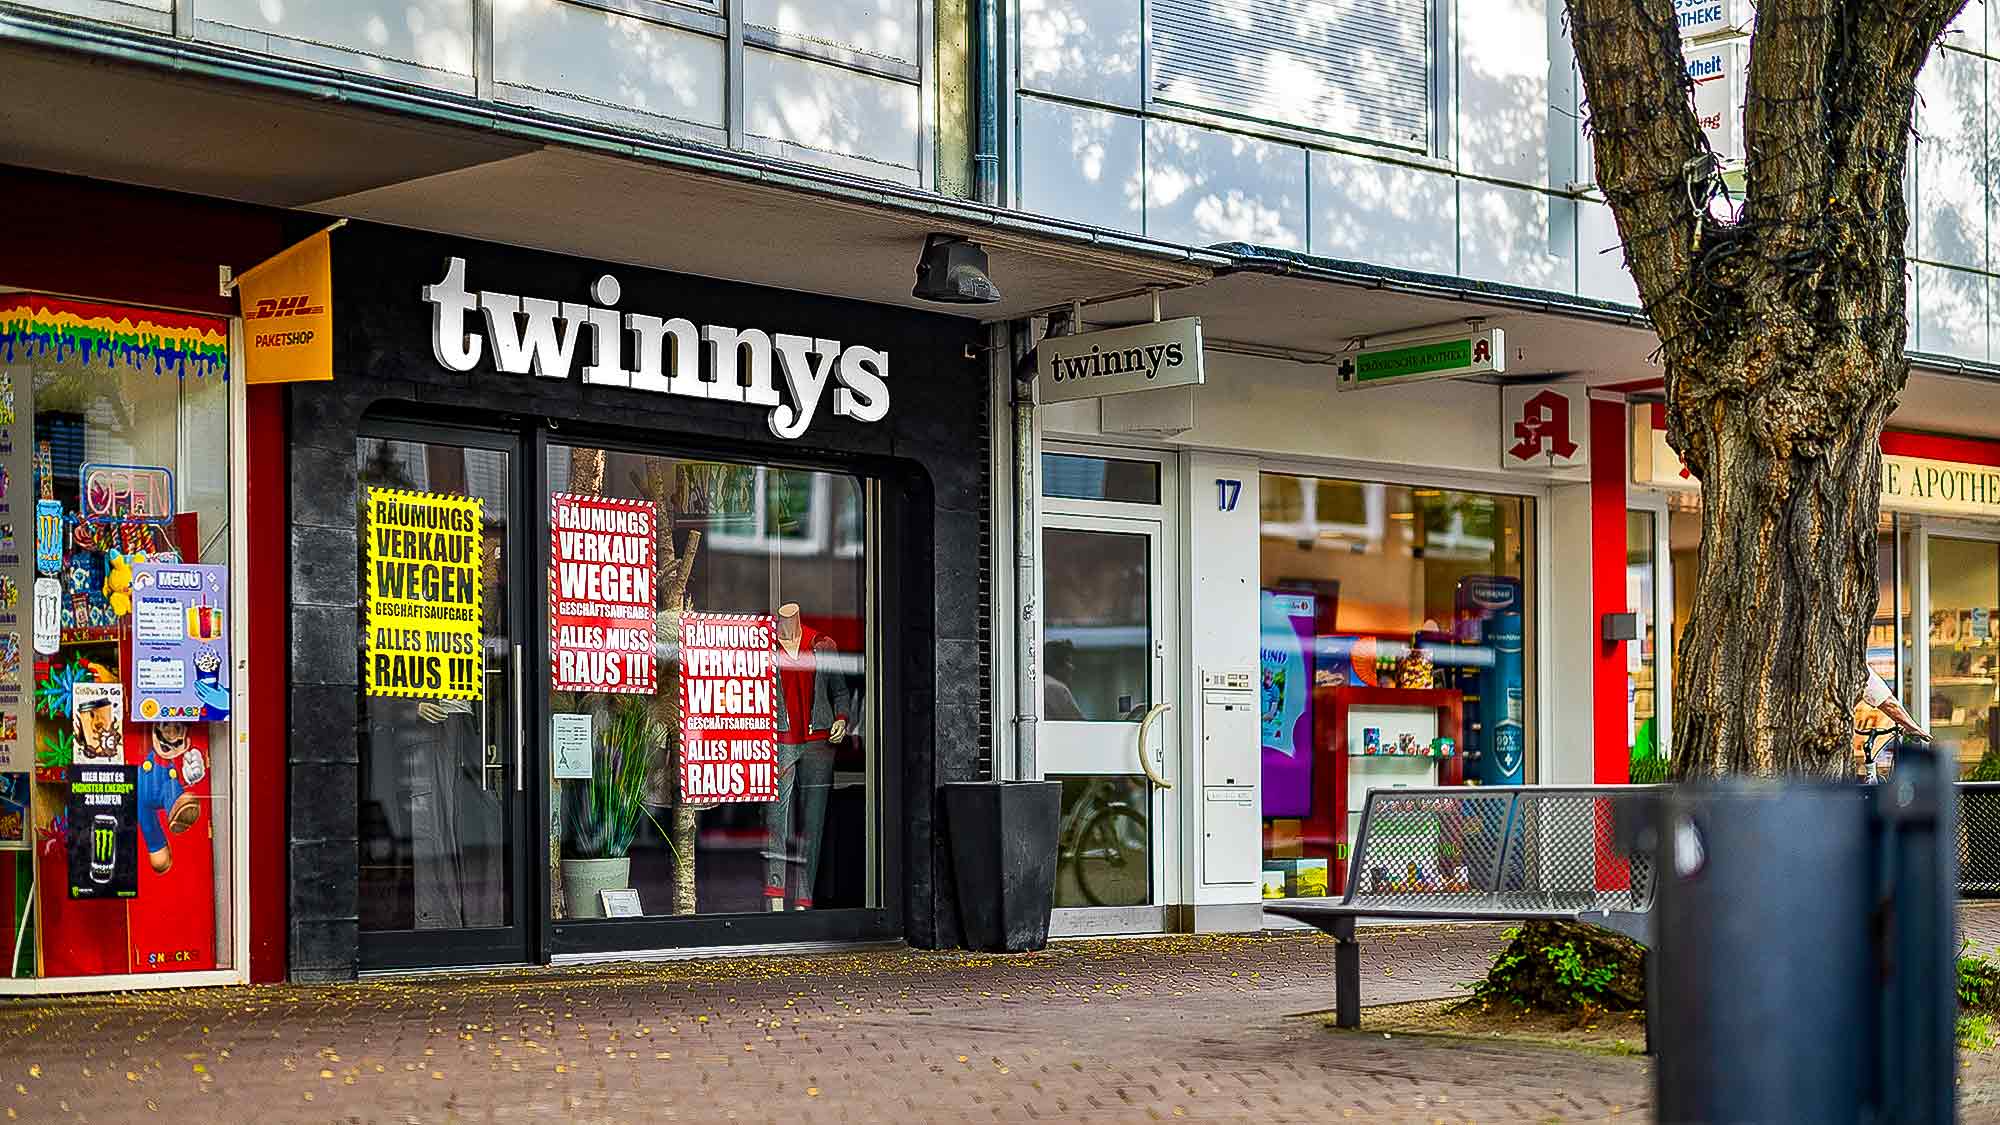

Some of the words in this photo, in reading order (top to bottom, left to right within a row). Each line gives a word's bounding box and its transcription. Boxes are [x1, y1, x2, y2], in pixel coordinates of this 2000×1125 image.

[1676, 5, 1721, 28] OTHEKE
[250, 296, 320, 319] DHL
[256, 331, 314, 347] PAKETSHOP
[422, 257, 889, 440] twinnys
[1051, 342, 1184, 382] twinnys
[88, 470, 168, 517] OPEN
[1216, 479, 1242, 511] 17
[376, 498, 474, 533] RÄUMUNGS
[559, 503, 650, 536] RÄUMUNGS
[376, 528, 474, 564] VERKAUF
[559, 531, 650, 566] VERKAUF
[159, 570, 200, 588] MENÜ
[376, 561, 474, 604] WEGEN
[559, 562, 650, 604] WEGEN
[375, 602, 474, 622] GESCHÄFTSAUFGABE
[559, 601, 650, 620] GESCHÄFTSAUFGABE
[375, 628, 421, 652] ALLES
[426, 631, 474, 654] MUSS
[559, 625, 603, 649] ALLES
[605, 628, 649, 651] MUSS
[685, 621, 769, 649] RÄUMUNGS
[375, 654, 442, 689] RAUS
[449, 658, 474, 691] !!!
[559, 650, 621, 685] RAUS
[625, 654, 649, 685] !!!
[686, 649, 770, 678] VERKAUF
[99, 687, 108, 696] To
[110, 687, 121, 696] Go
[687, 679, 770, 715] WEGEN
[687, 715, 771, 731] GESCHÄFTSAUFGABE
[687, 739, 728, 761] ALLES
[730, 740, 771, 761] MUSS
[72, 782, 104, 793] MONSTER
[687, 763, 745, 795] RAUS
[749, 763, 771, 794] !!!
